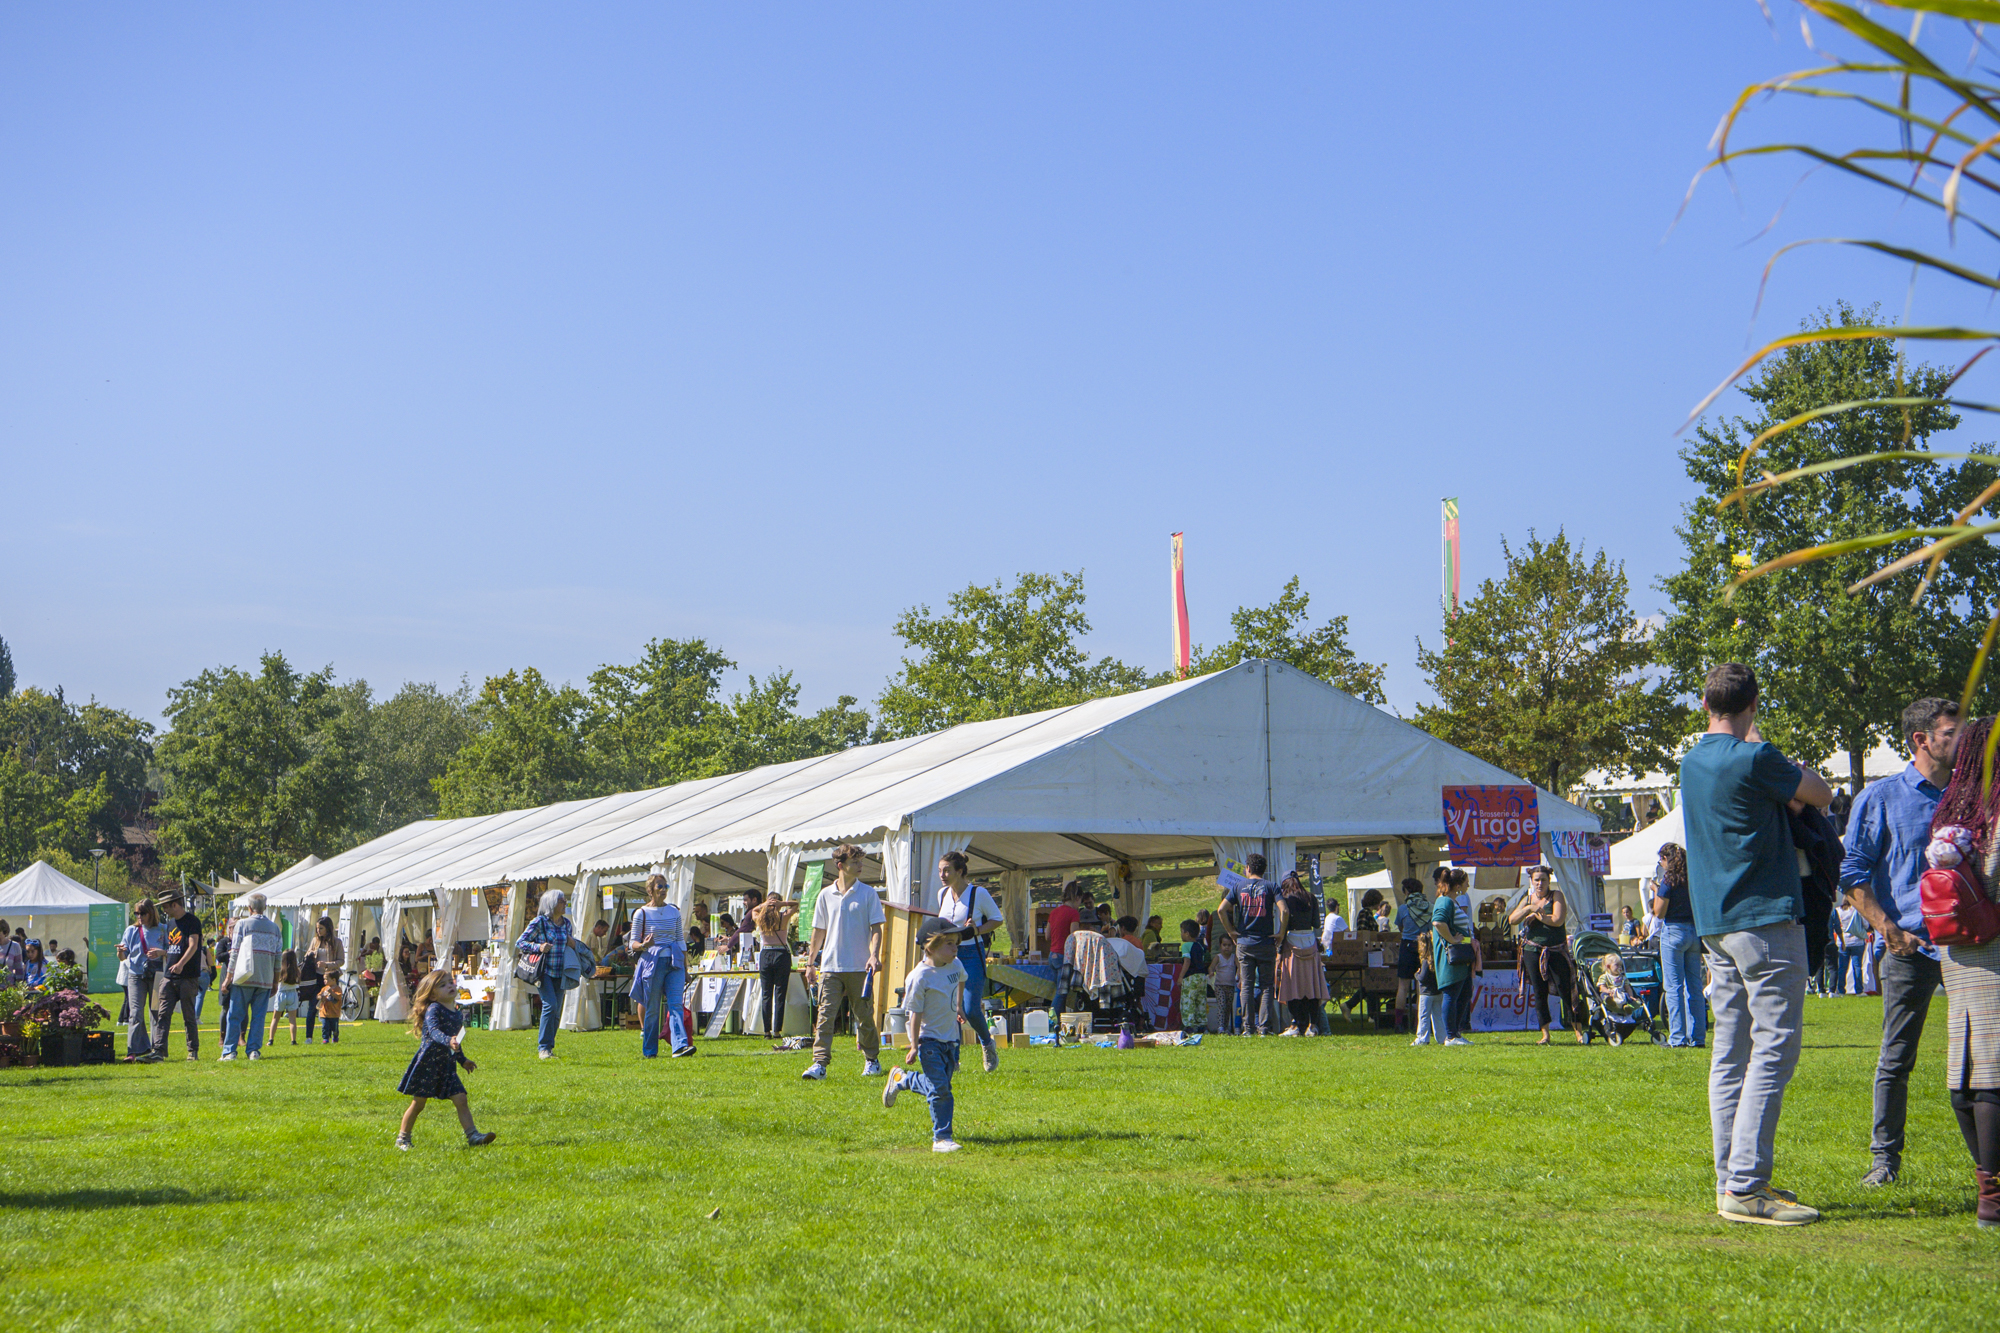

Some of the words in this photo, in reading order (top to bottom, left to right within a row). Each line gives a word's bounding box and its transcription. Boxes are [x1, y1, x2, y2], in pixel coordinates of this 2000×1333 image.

[1480, 809, 1509, 817] Brasserie
[1511, 809, 1519, 817] du
[1447, 809, 1537, 844] Virage
